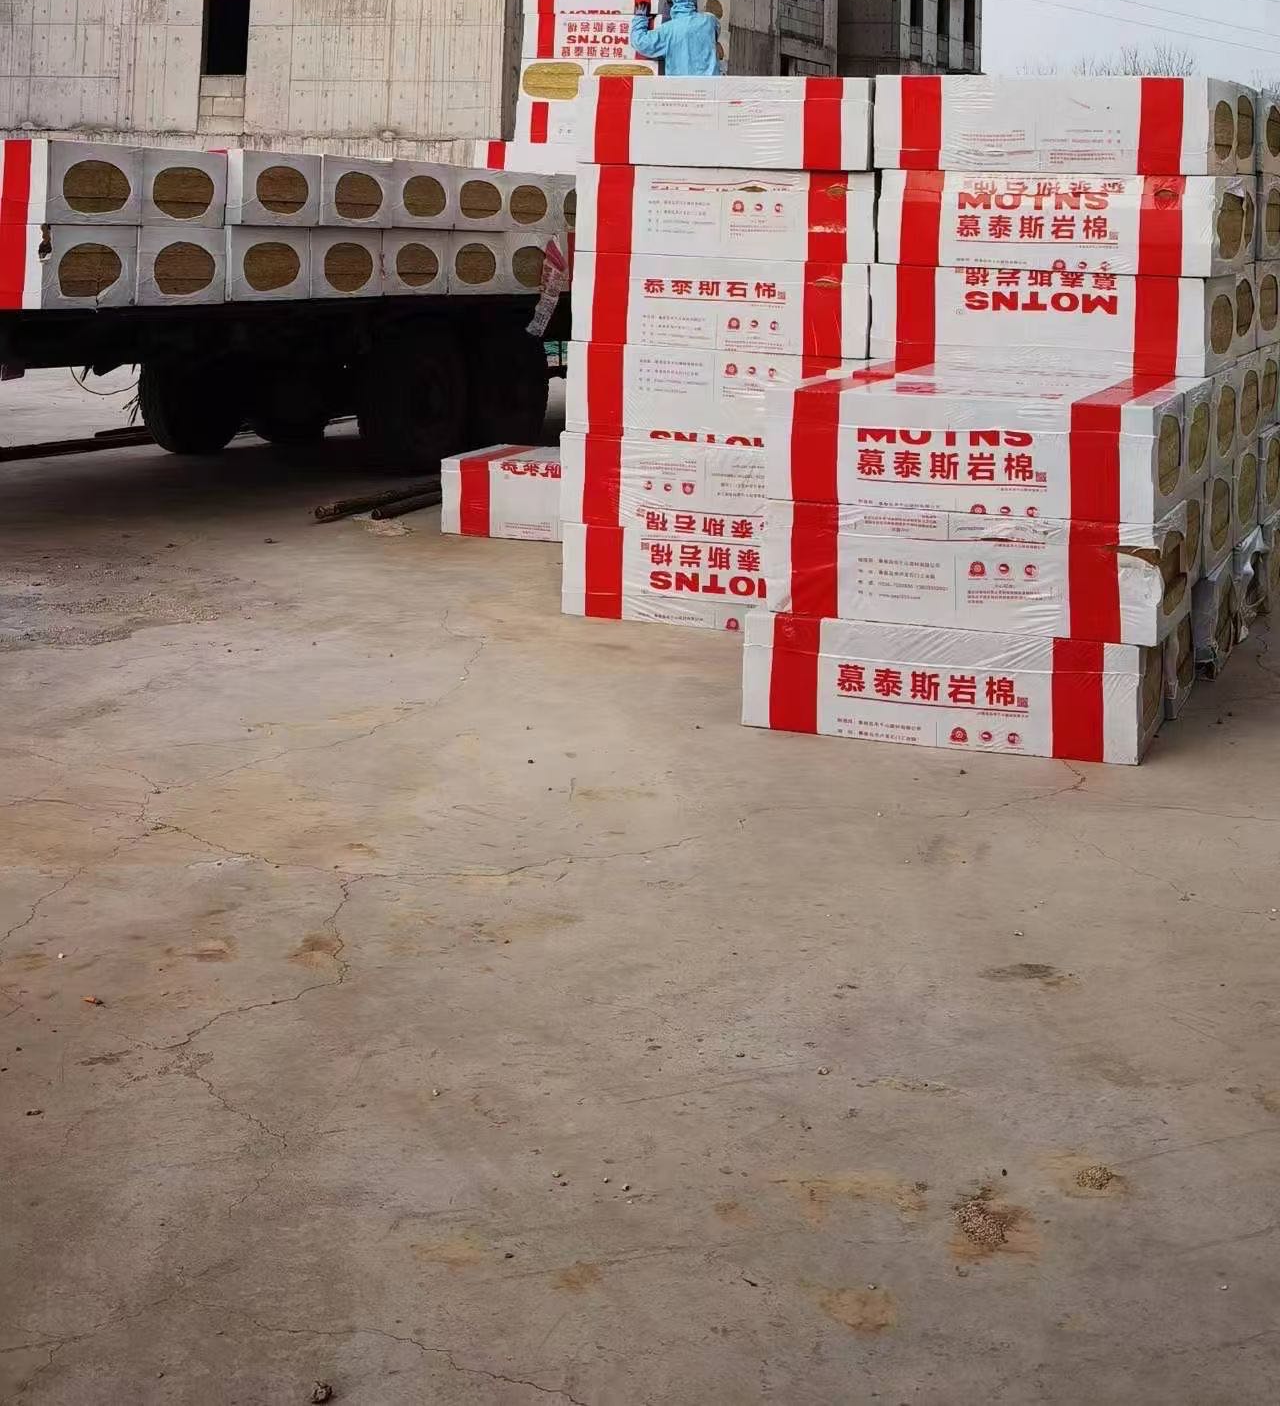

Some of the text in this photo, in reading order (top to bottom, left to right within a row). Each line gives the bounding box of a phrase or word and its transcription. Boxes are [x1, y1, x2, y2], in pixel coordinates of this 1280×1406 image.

[567, 35, 628, 45] MOTNS
[958, 191, 1110, 210] MOTNS
[956, 215, 1107, 239] 慕泰斯岩棉
[965, 291, 1118, 315] MOTNS
[857, 448, 1033, 482] 慕泰斯岩棉
[651, 543, 760, 574] 泰斯岩棉
[837, 664, 1015, 706] 慕泰斯岩棉
